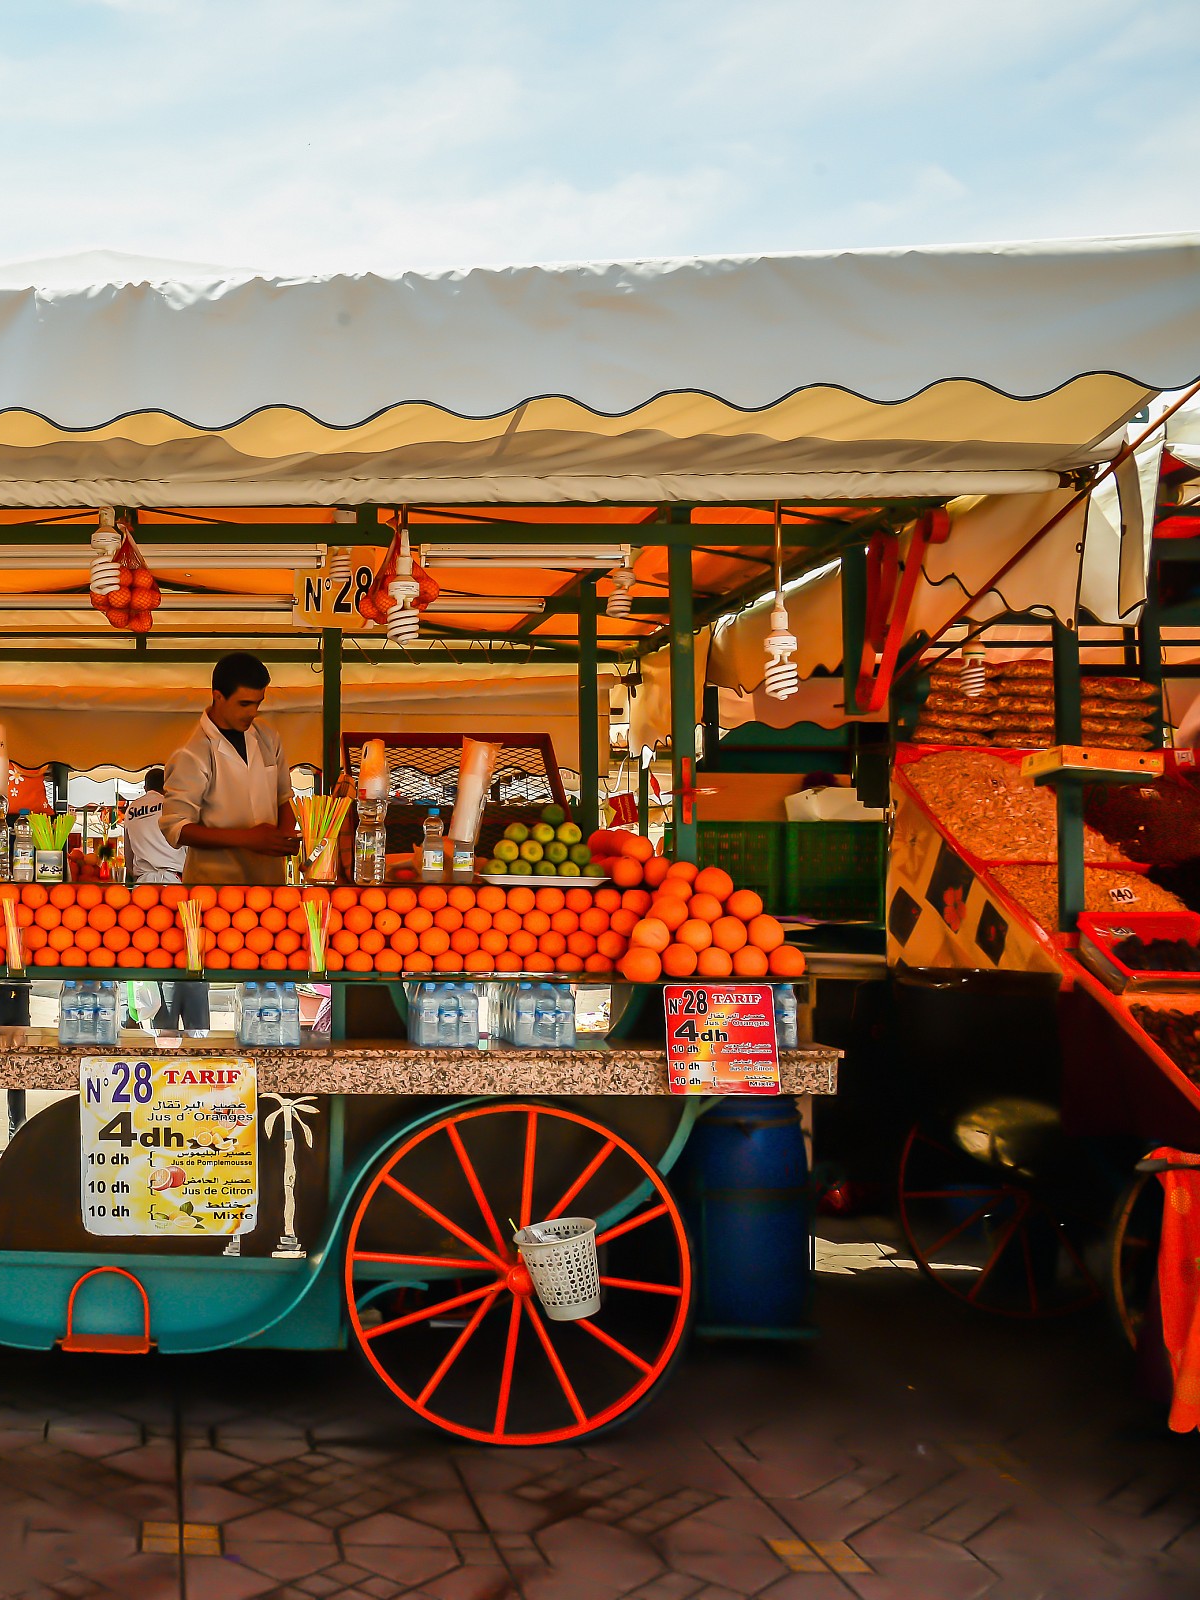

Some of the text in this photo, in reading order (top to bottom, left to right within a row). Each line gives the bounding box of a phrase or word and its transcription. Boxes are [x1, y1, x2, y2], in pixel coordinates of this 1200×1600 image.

[305, 566, 373, 614] N°28
[129, 805, 148, 820] Sidi
[1111, 888, 1133, 902] 140
[669, 990, 762, 1014] N°28 TARIF
[674, 1020, 728, 1042] 4dh
[672, 1045, 699, 1053] 10 dh
[86, 1062, 241, 1103] N°28 TARIF
[153, 1101, 246, 1111] عصير البرتقال
[147, 1113, 171, 1121] Jus
[194, 1113, 253, 1122] Oranges
[99, 1112, 184, 1147] 4dh
[88, 1153, 129, 1165] 10 dh
[223, 1150, 252, 1158] عصير
[88, 1181, 130, 1193] 10 dh
[182, 1187, 253, 1195] Jus de Citron
[88, 1205, 130, 1217] 10 dh
[213, 1211, 253, 1219] Mixte
